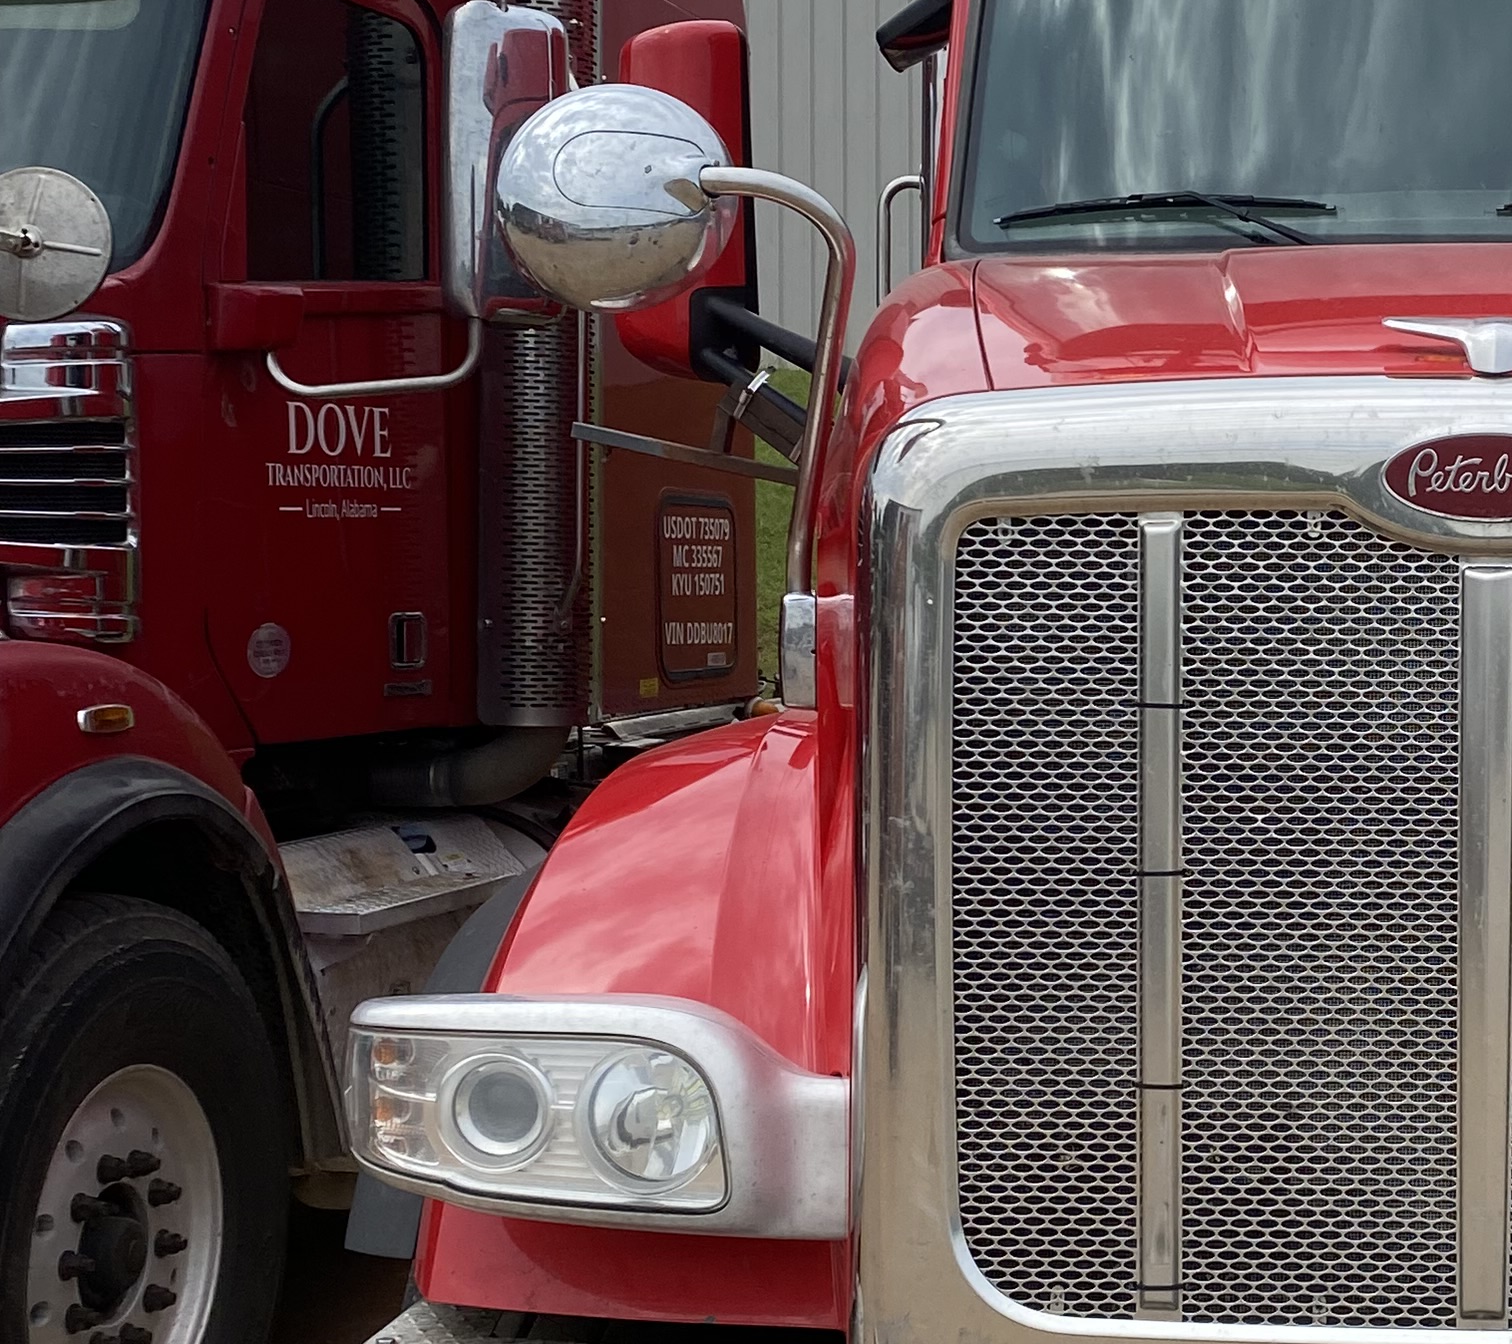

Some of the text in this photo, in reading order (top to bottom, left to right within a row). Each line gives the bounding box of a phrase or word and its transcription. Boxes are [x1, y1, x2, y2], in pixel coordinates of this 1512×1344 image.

[286, 401, 392, 457] DOVE
[265, 462, 411, 491] TRANSPORTATION, LLC
[306, 498, 377, 520] Lincoln, Alabama
[663, 516, 730, 540] USDOT 735079
[673, 544, 722, 568] MC 335567
[672, 573, 725, 596] KYU 150751
[665, 622, 684, 645] VIN
